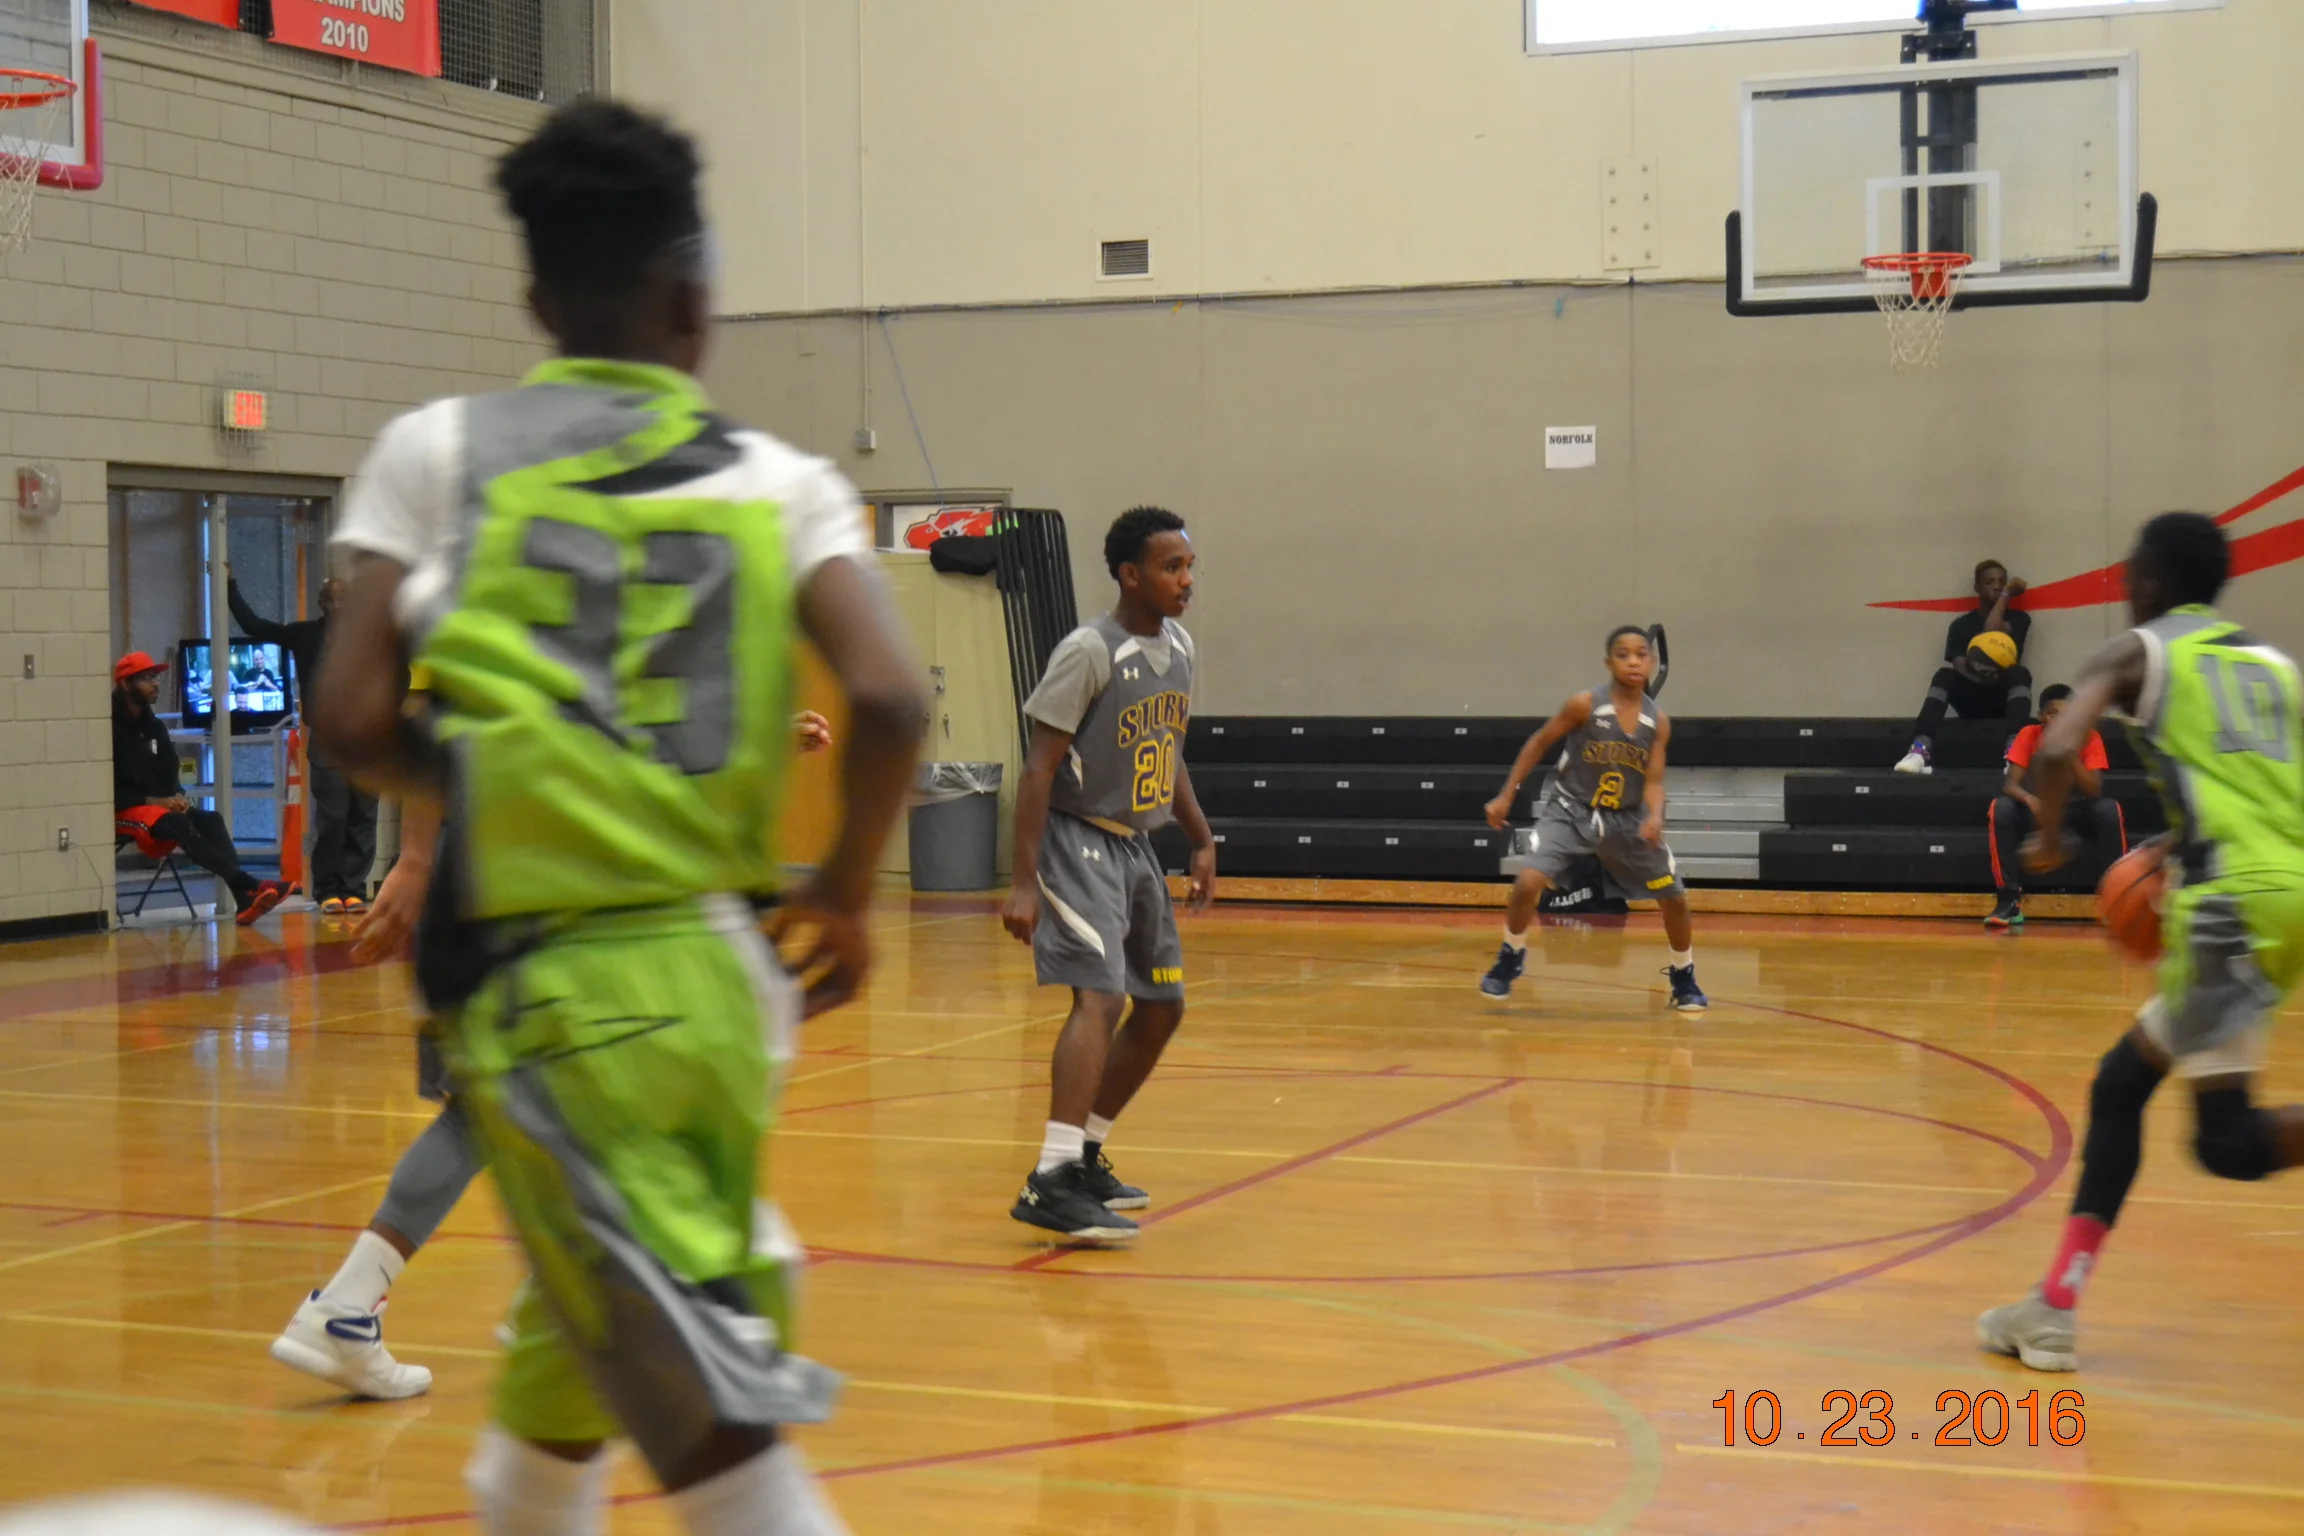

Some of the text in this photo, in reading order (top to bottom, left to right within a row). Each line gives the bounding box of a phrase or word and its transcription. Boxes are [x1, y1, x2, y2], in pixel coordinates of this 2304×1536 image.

[320, 16, 369, 53] 2010
[1549, 433, 1593, 445] NORFOLK
[1132, 732, 1175, 813] 20
[1590, 771, 1625, 810] 2
